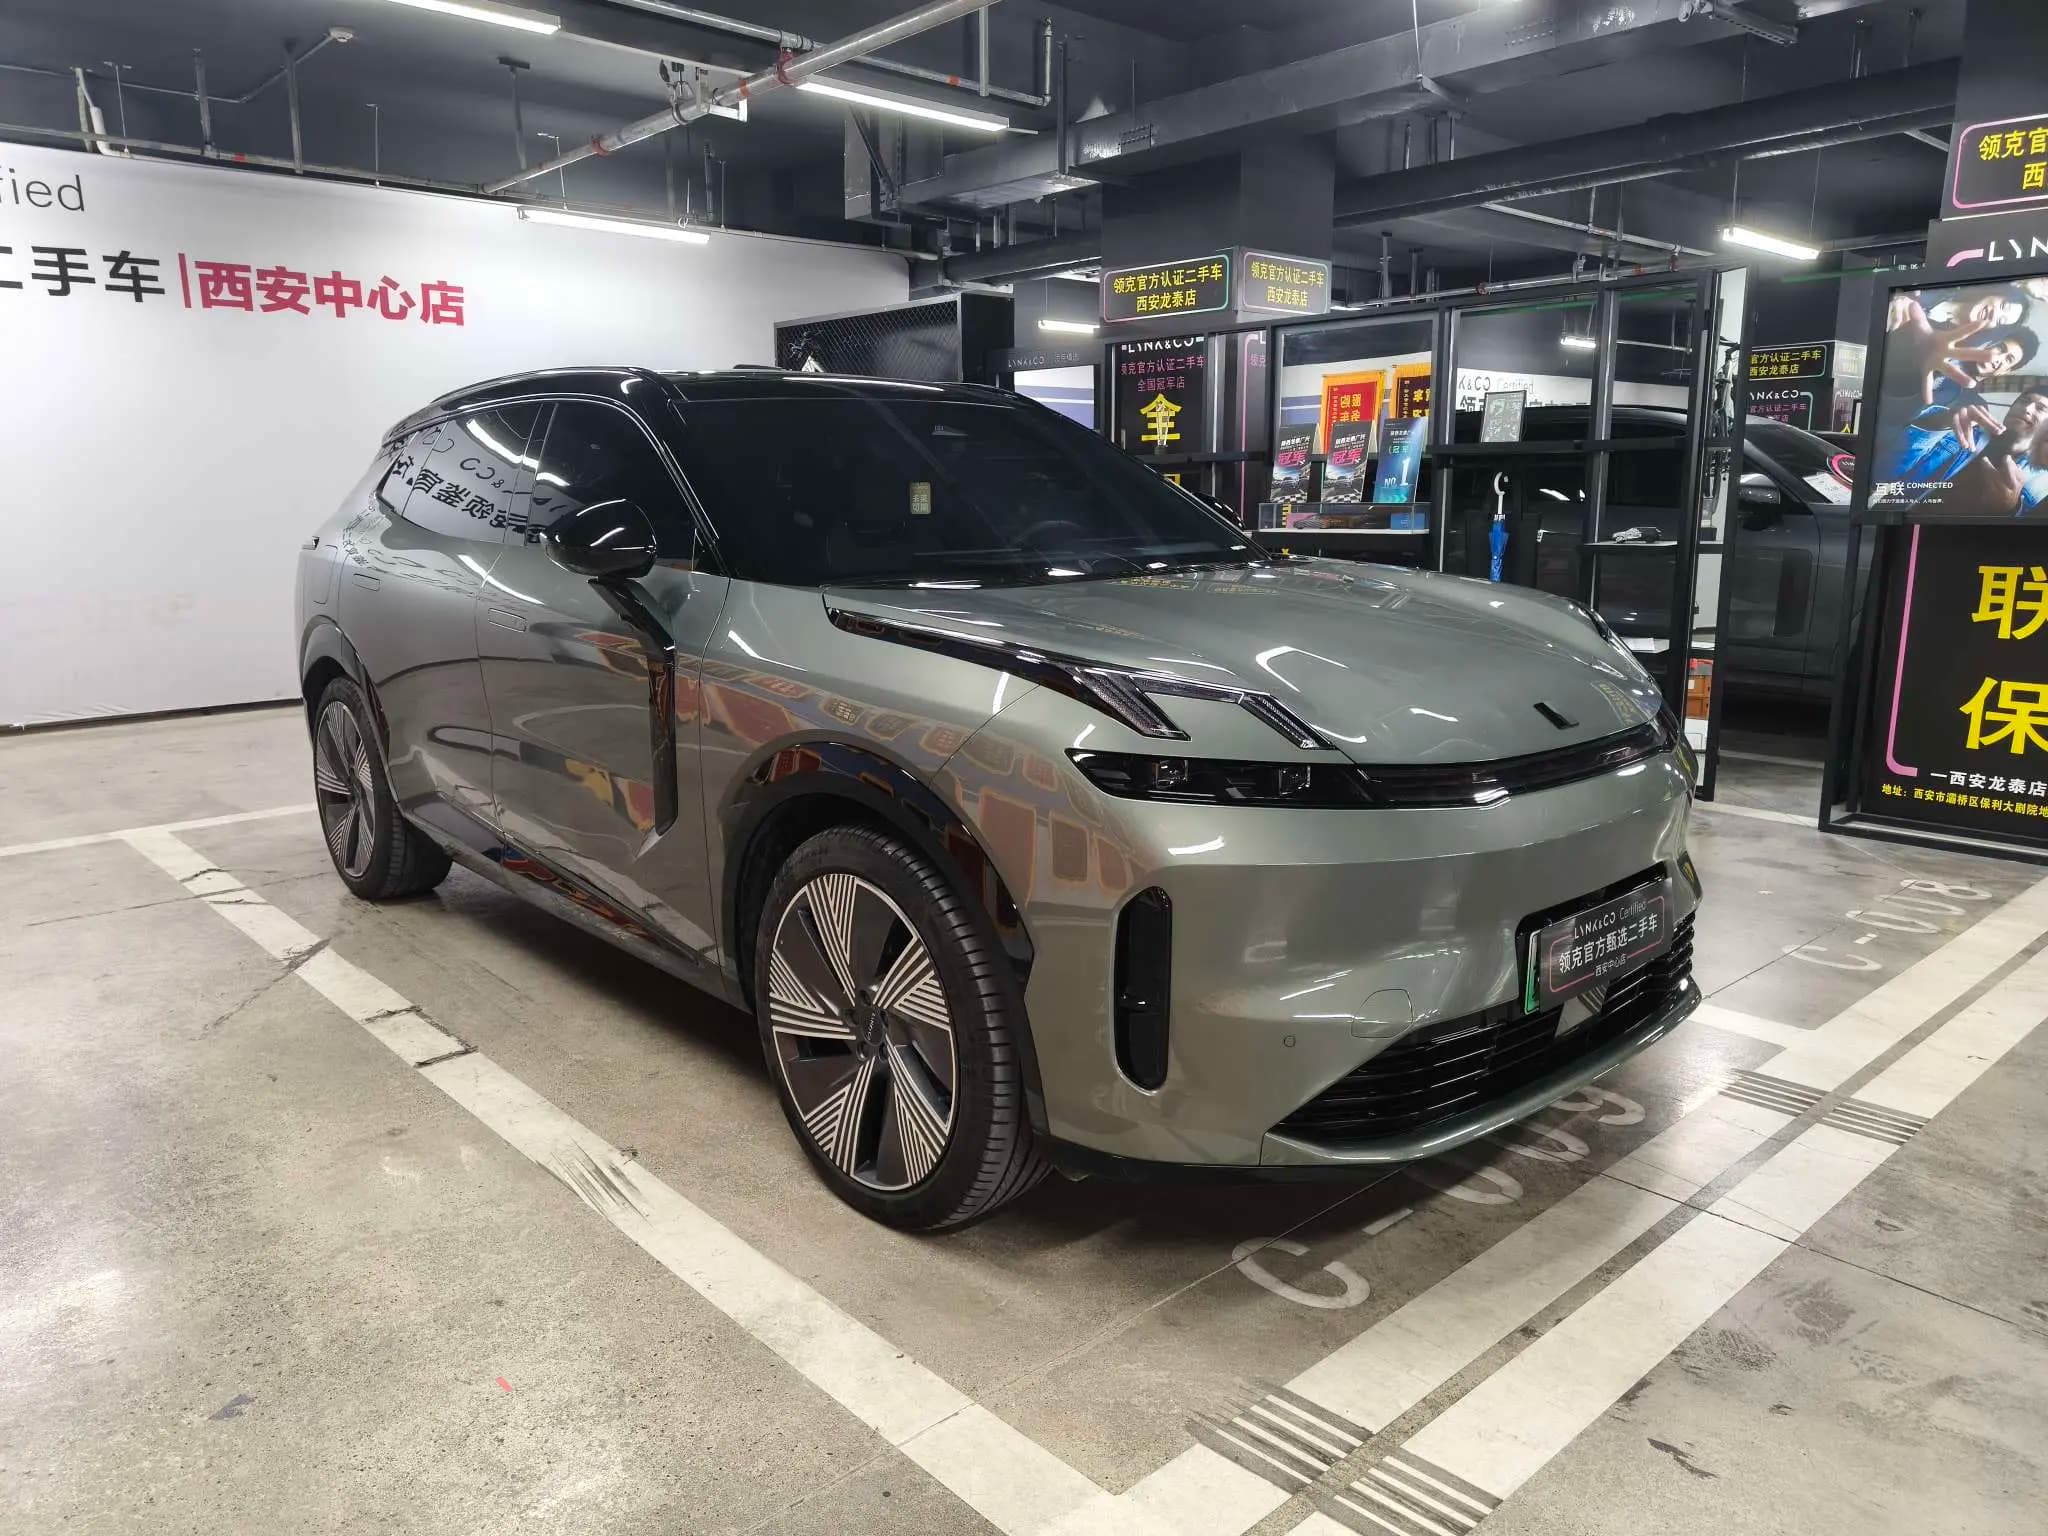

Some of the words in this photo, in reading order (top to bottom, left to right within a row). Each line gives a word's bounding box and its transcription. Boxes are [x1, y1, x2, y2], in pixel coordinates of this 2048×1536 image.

[1979, 126, 2048, 161] 领克官
[0, 165, 85, 212] ied
[1113, 263, 1223, 294] 领克官方认证二手车
[1251, 261, 1325, 288] 领克官方认证二手车
[195, 260, 465, 327] 西安中心店
[1136, 288, 1197, 313] 西安龙泰店
[1267, 286, 1308, 307] 西安龙泰店
[1749, 364, 1799, 376] 西安龙泰店
[1138, 376, 1185, 392] 全国冠军店
[1875, 481, 1905, 496] 互联
[1906, 481, 1954, 489] CONNECTED
[1959, 676, 2048, 755] 保
[1574, 912, 1616, 939] LYNK&CO
[1559, 912, 1658, 974] 领克官方甄选二手车
